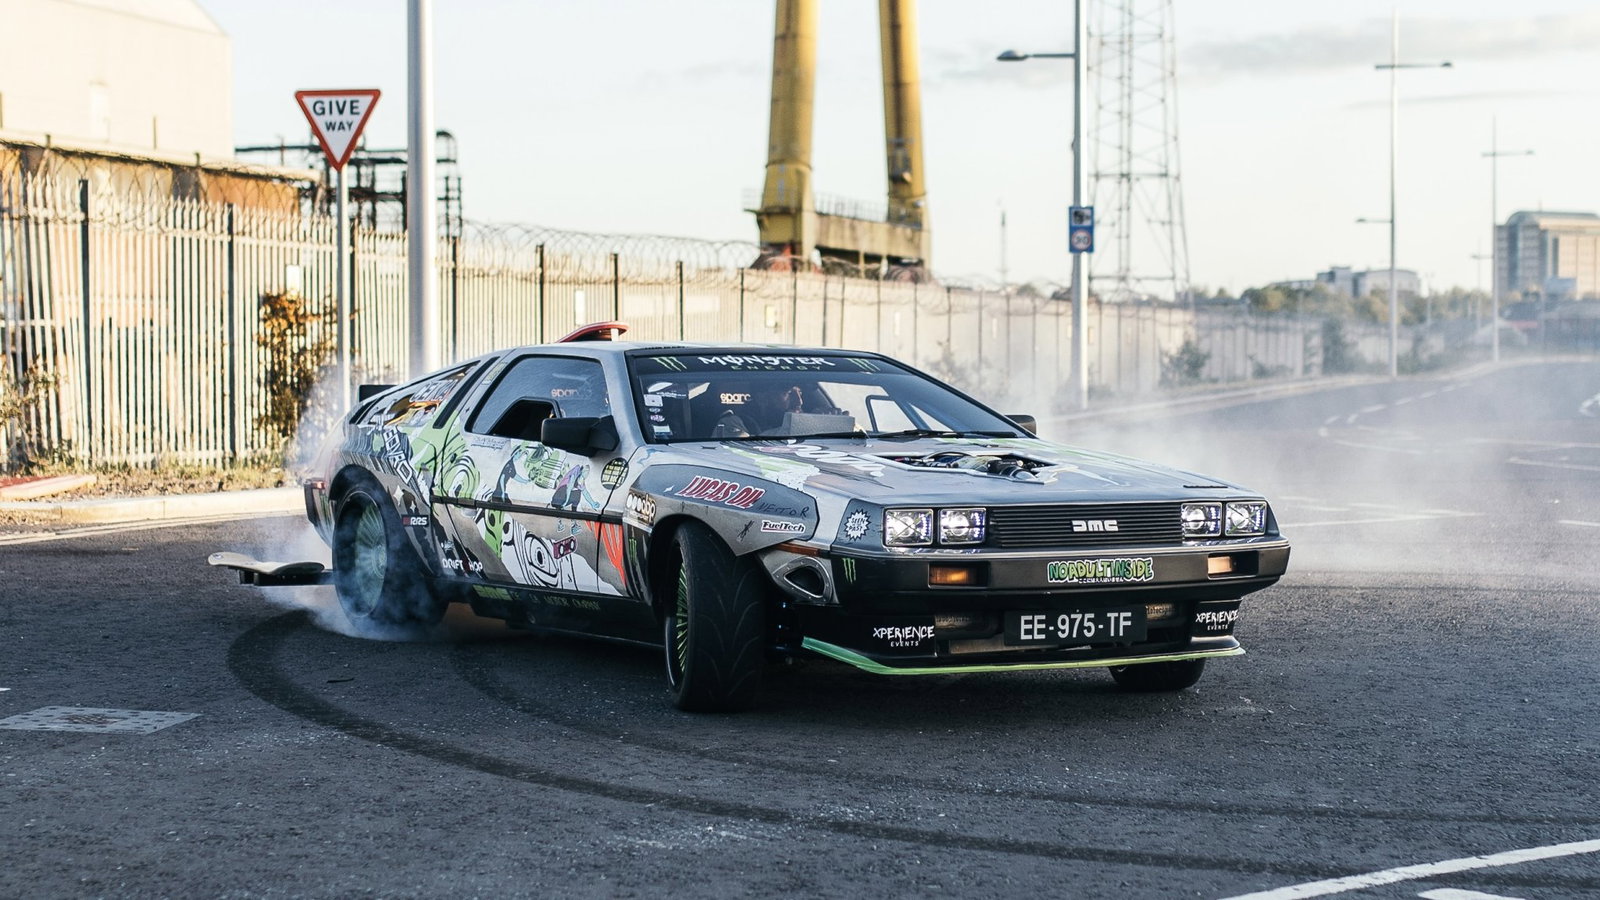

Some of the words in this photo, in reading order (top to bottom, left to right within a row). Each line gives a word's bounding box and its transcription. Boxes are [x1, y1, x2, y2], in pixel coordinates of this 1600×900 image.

[312, 100, 360, 116] GIVE
[325, 121, 353, 132] WAY
[698, 354, 836, 366] MONSTER
[675, 476, 739, 502] LUCAS
[726, 486, 765, 508] OIL
[410, 516, 428, 526] RRS
[762, 521, 805, 533] FuelTech
[1071, 519, 1119, 532] DMC
[1195, 609, 1239, 624] XPERIENCE
[1020, 612, 1132, 640] EE-975-TF
[873, 626, 935, 641] XPERIENCE
